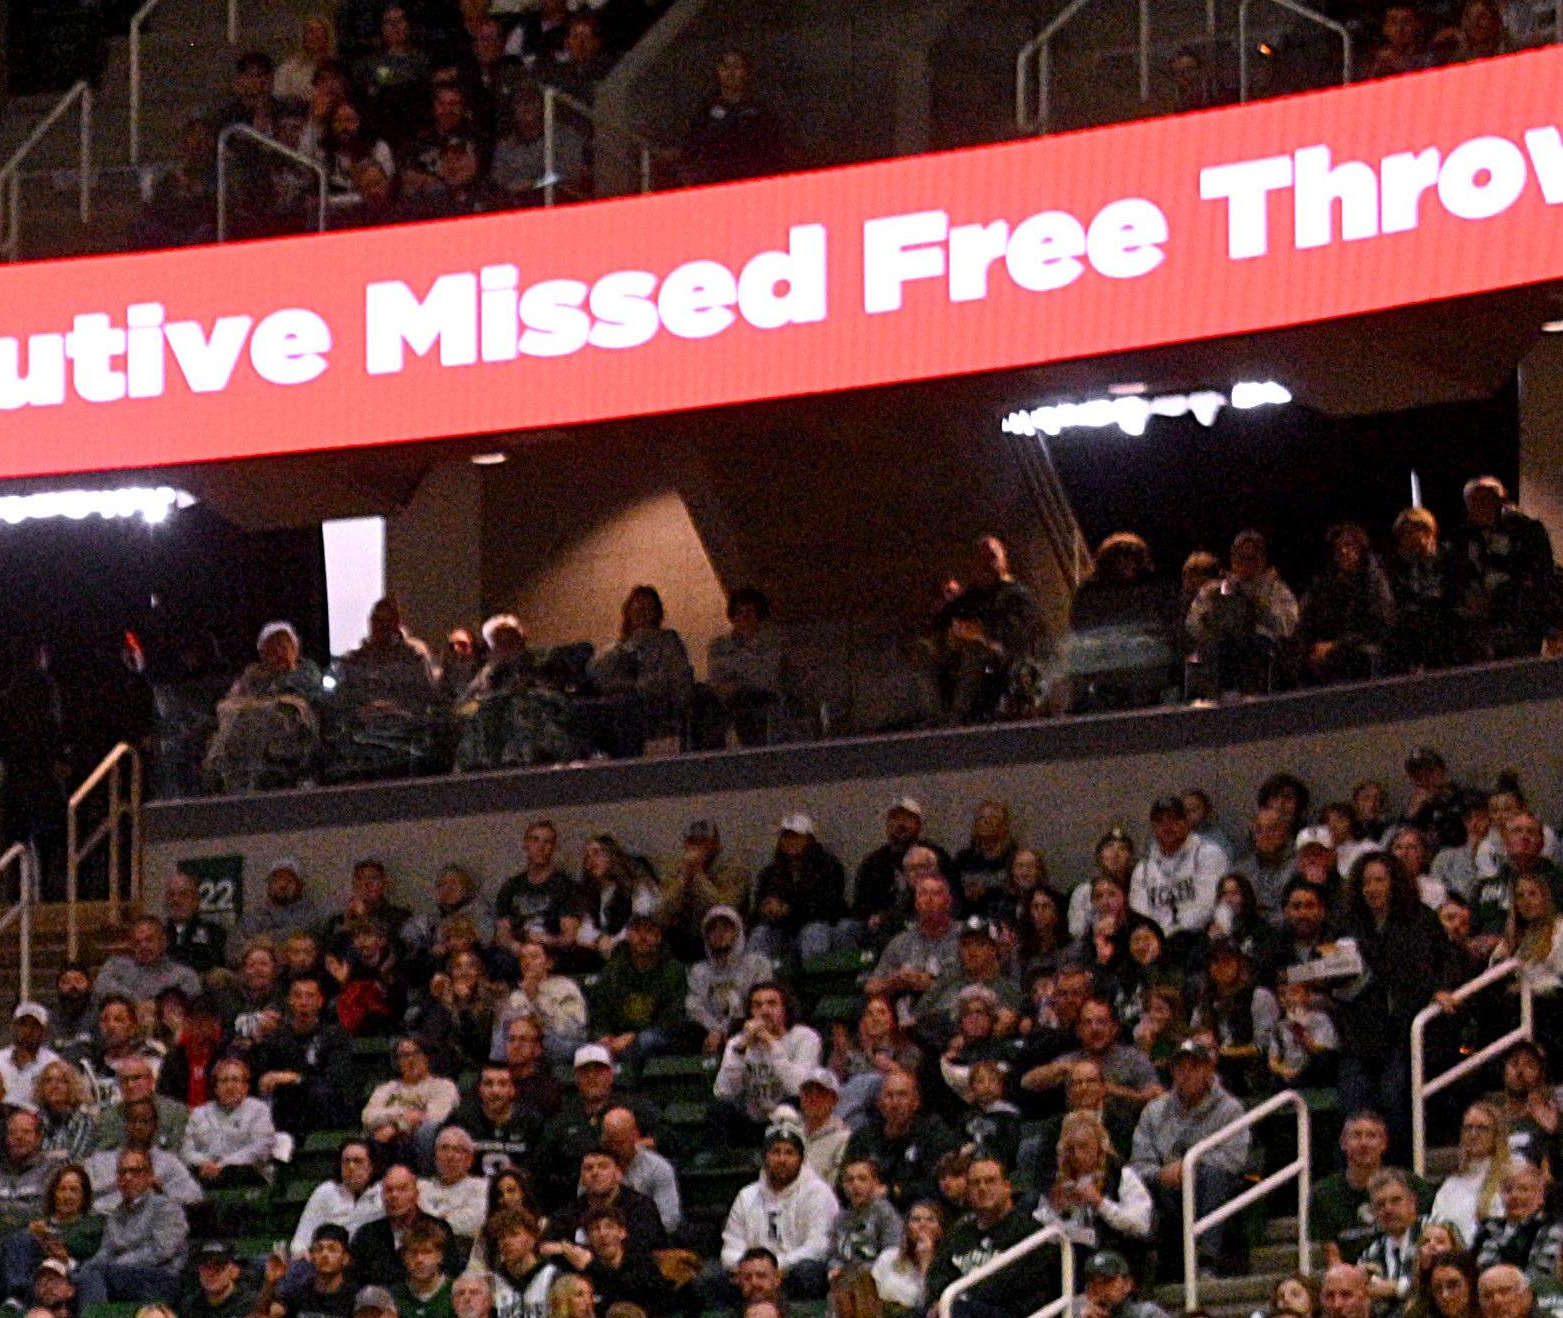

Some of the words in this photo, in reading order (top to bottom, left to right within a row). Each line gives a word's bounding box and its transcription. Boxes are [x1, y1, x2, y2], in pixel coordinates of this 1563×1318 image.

[365, 225, 826, 375] Missed
[864, 198, 1169, 314] Free
[198, 879, 234, 909] 22
